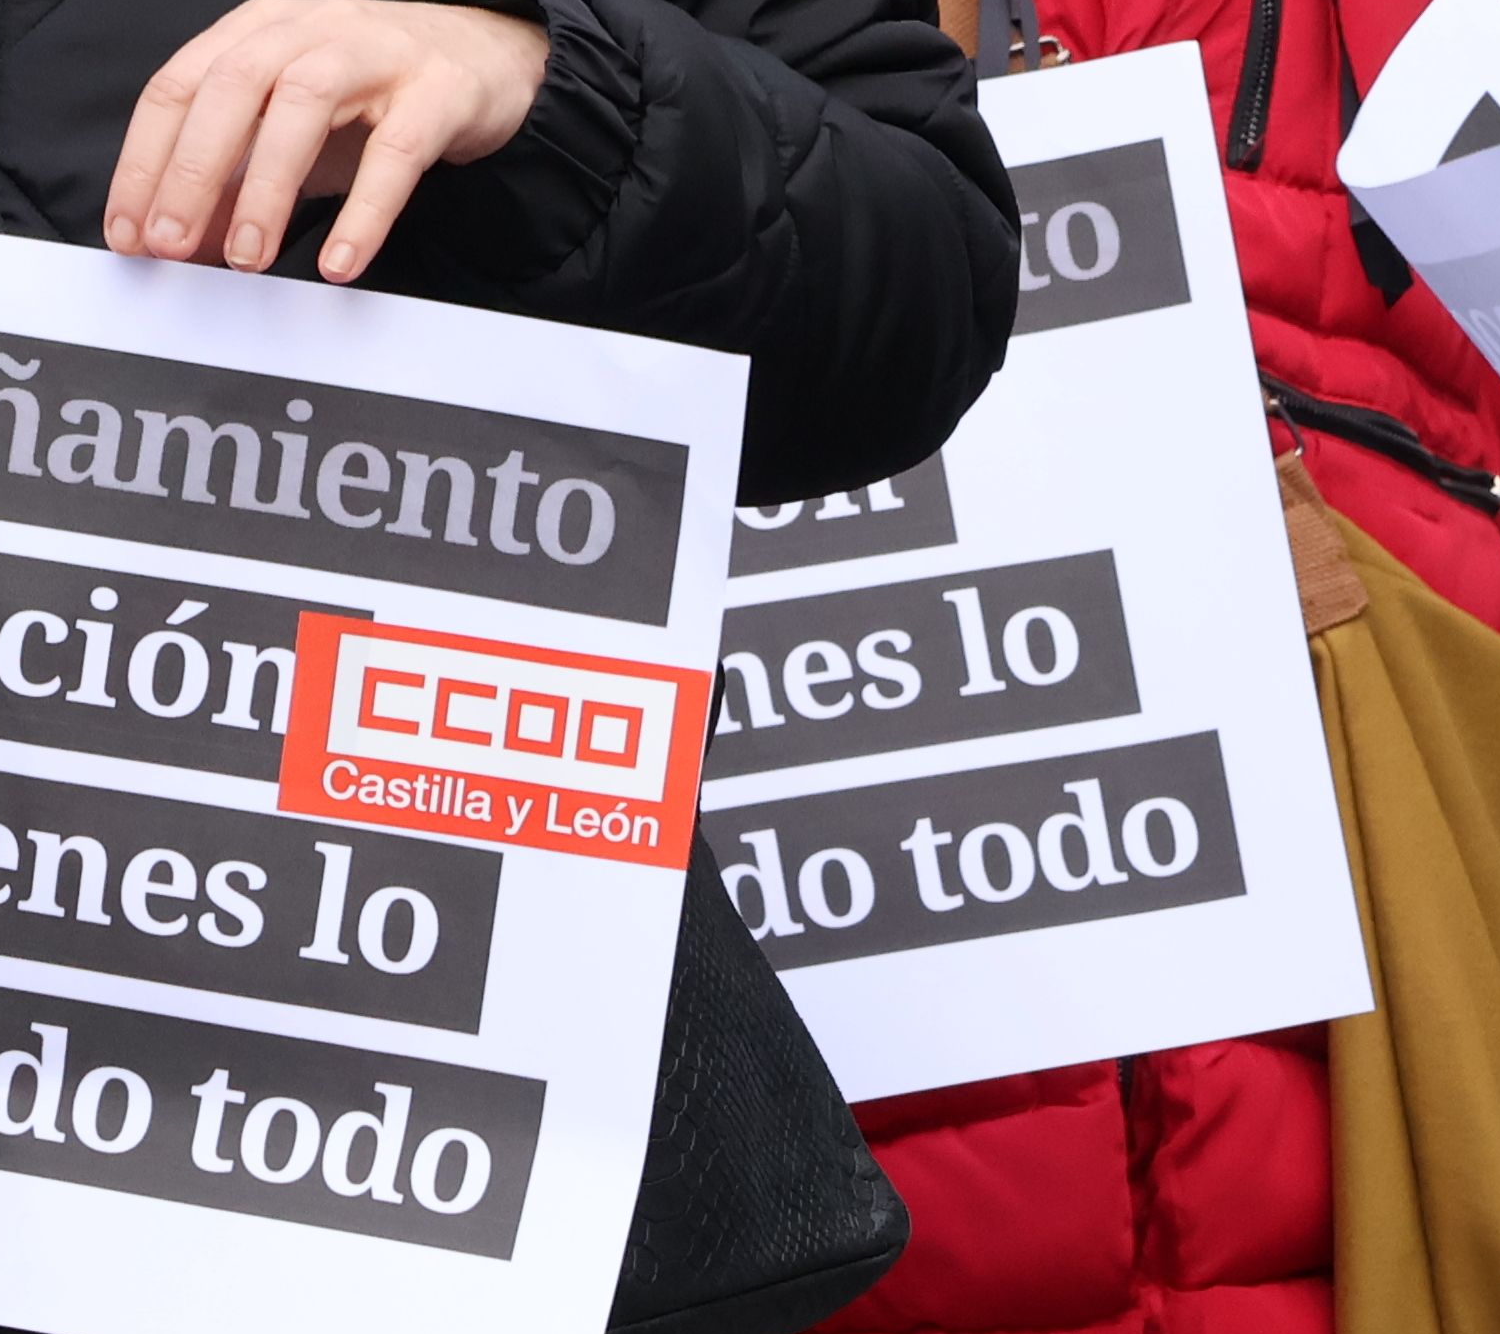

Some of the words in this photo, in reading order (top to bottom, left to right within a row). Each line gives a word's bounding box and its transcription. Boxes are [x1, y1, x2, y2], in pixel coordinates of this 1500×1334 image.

[1019, 201, 1120, 291] to
[357, 666, 645, 770] CCOO
[714, 629, 923, 735] nes
[942, 586, 1080, 696] lo
[322, 759, 493, 823] Castilla
[504, 794, 534, 836] y
[545, 791, 660, 848] León
[719, 827, 876, 942] do
[900, 776, 1200, 913] todo
[298, 841, 440, 975] lo
[190, 1068, 493, 1216] todo
